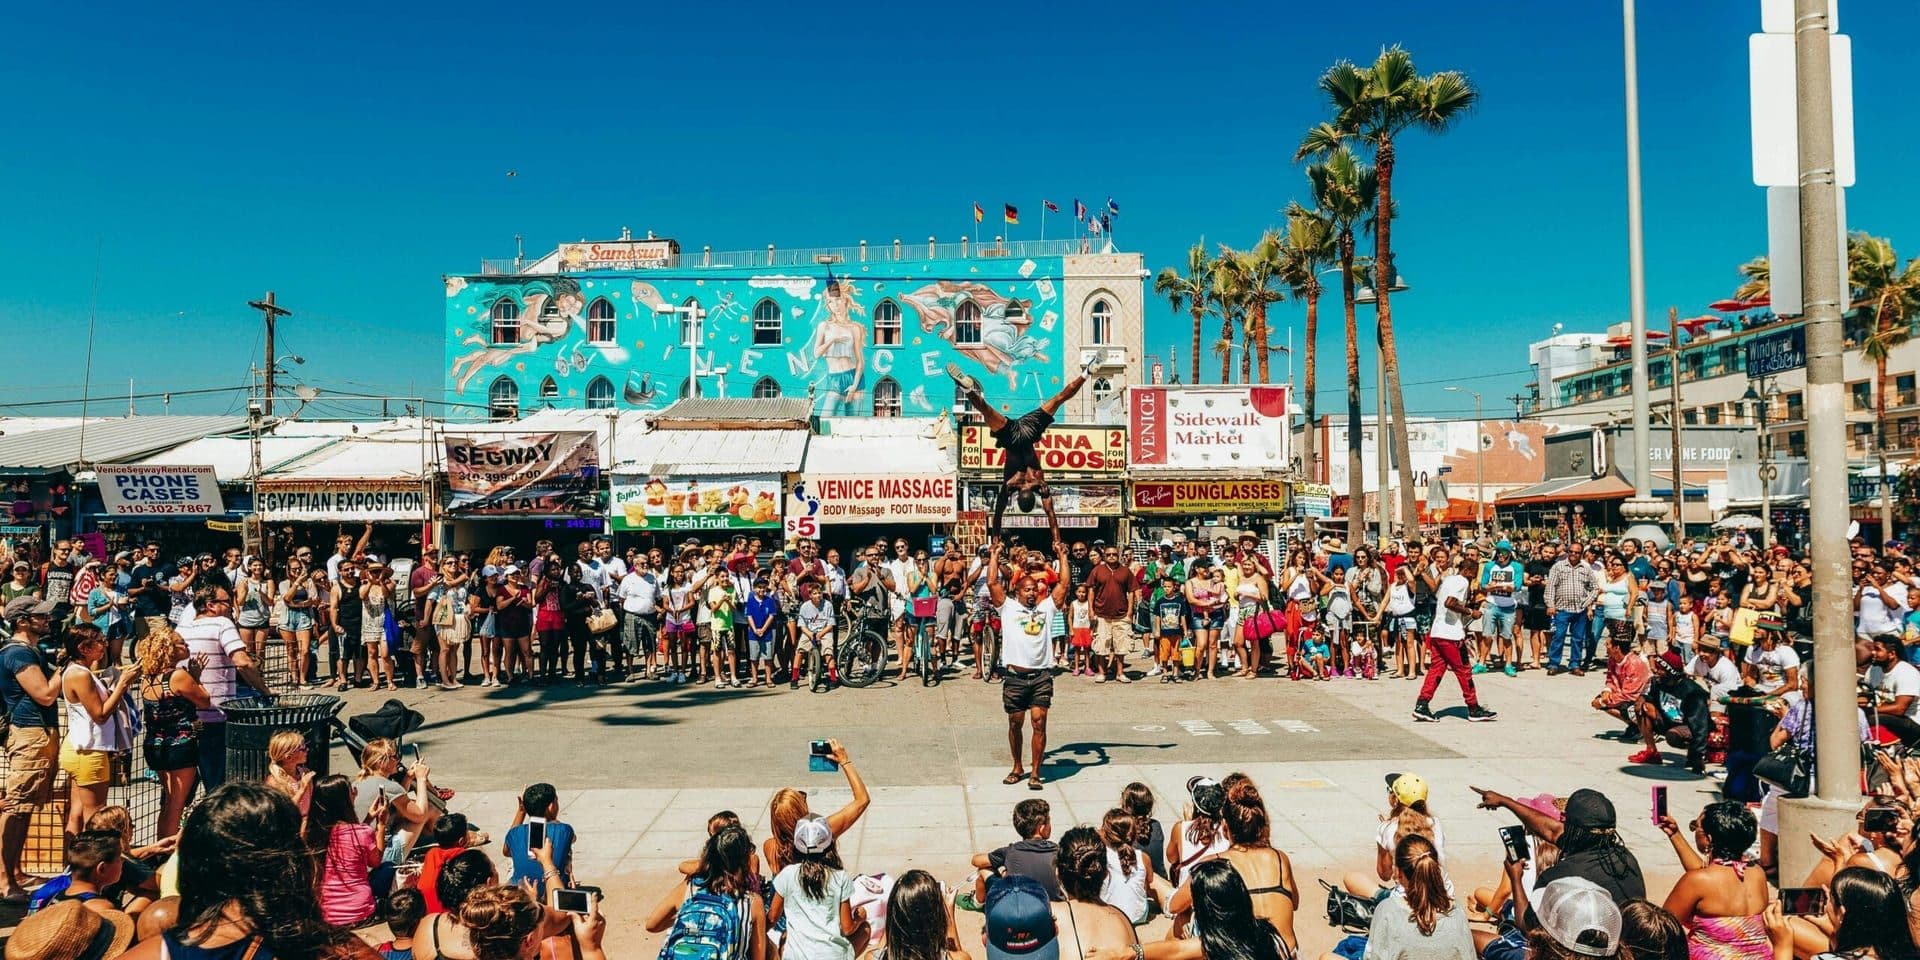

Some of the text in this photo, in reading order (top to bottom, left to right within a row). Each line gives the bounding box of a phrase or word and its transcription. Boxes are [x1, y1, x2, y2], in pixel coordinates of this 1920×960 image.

[589, 244, 665, 260] Samesun
[1749, 338, 1787, 361] Windwa
[1174, 412, 1262, 426] Sidewalk
[1140, 392, 1155, 461] VENICE
[965, 427, 977, 444] 2
[1110, 431, 1122, 447] 2
[1175, 430, 1244, 445] Market
[453, 443, 554, 466] SEGWAY
[963, 455, 979, 465] $10
[1700, 447, 1731, 460] FOOD
[96, 466, 211, 475] VeniceSegwayRental.com
[1107, 458, 1124, 469] $10
[115, 475, 199, 487] PHONE
[122, 487, 200, 501] CASES
[818, 479, 953, 499] VENICE MASSAGE
[1176, 484, 1280, 499] SUNGLASSES
[117, 504, 212, 513] 310-302-7867
[257, 492, 423, 512] EGYPTIAN EXPOSITION
[823, 505, 847, 515] BODY
[849, 505, 885, 516] Massage
[890, 504, 913, 514] FOOT
[915, 504, 951, 516] Massage
[663, 517, 730, 528] Fresh Fruit
